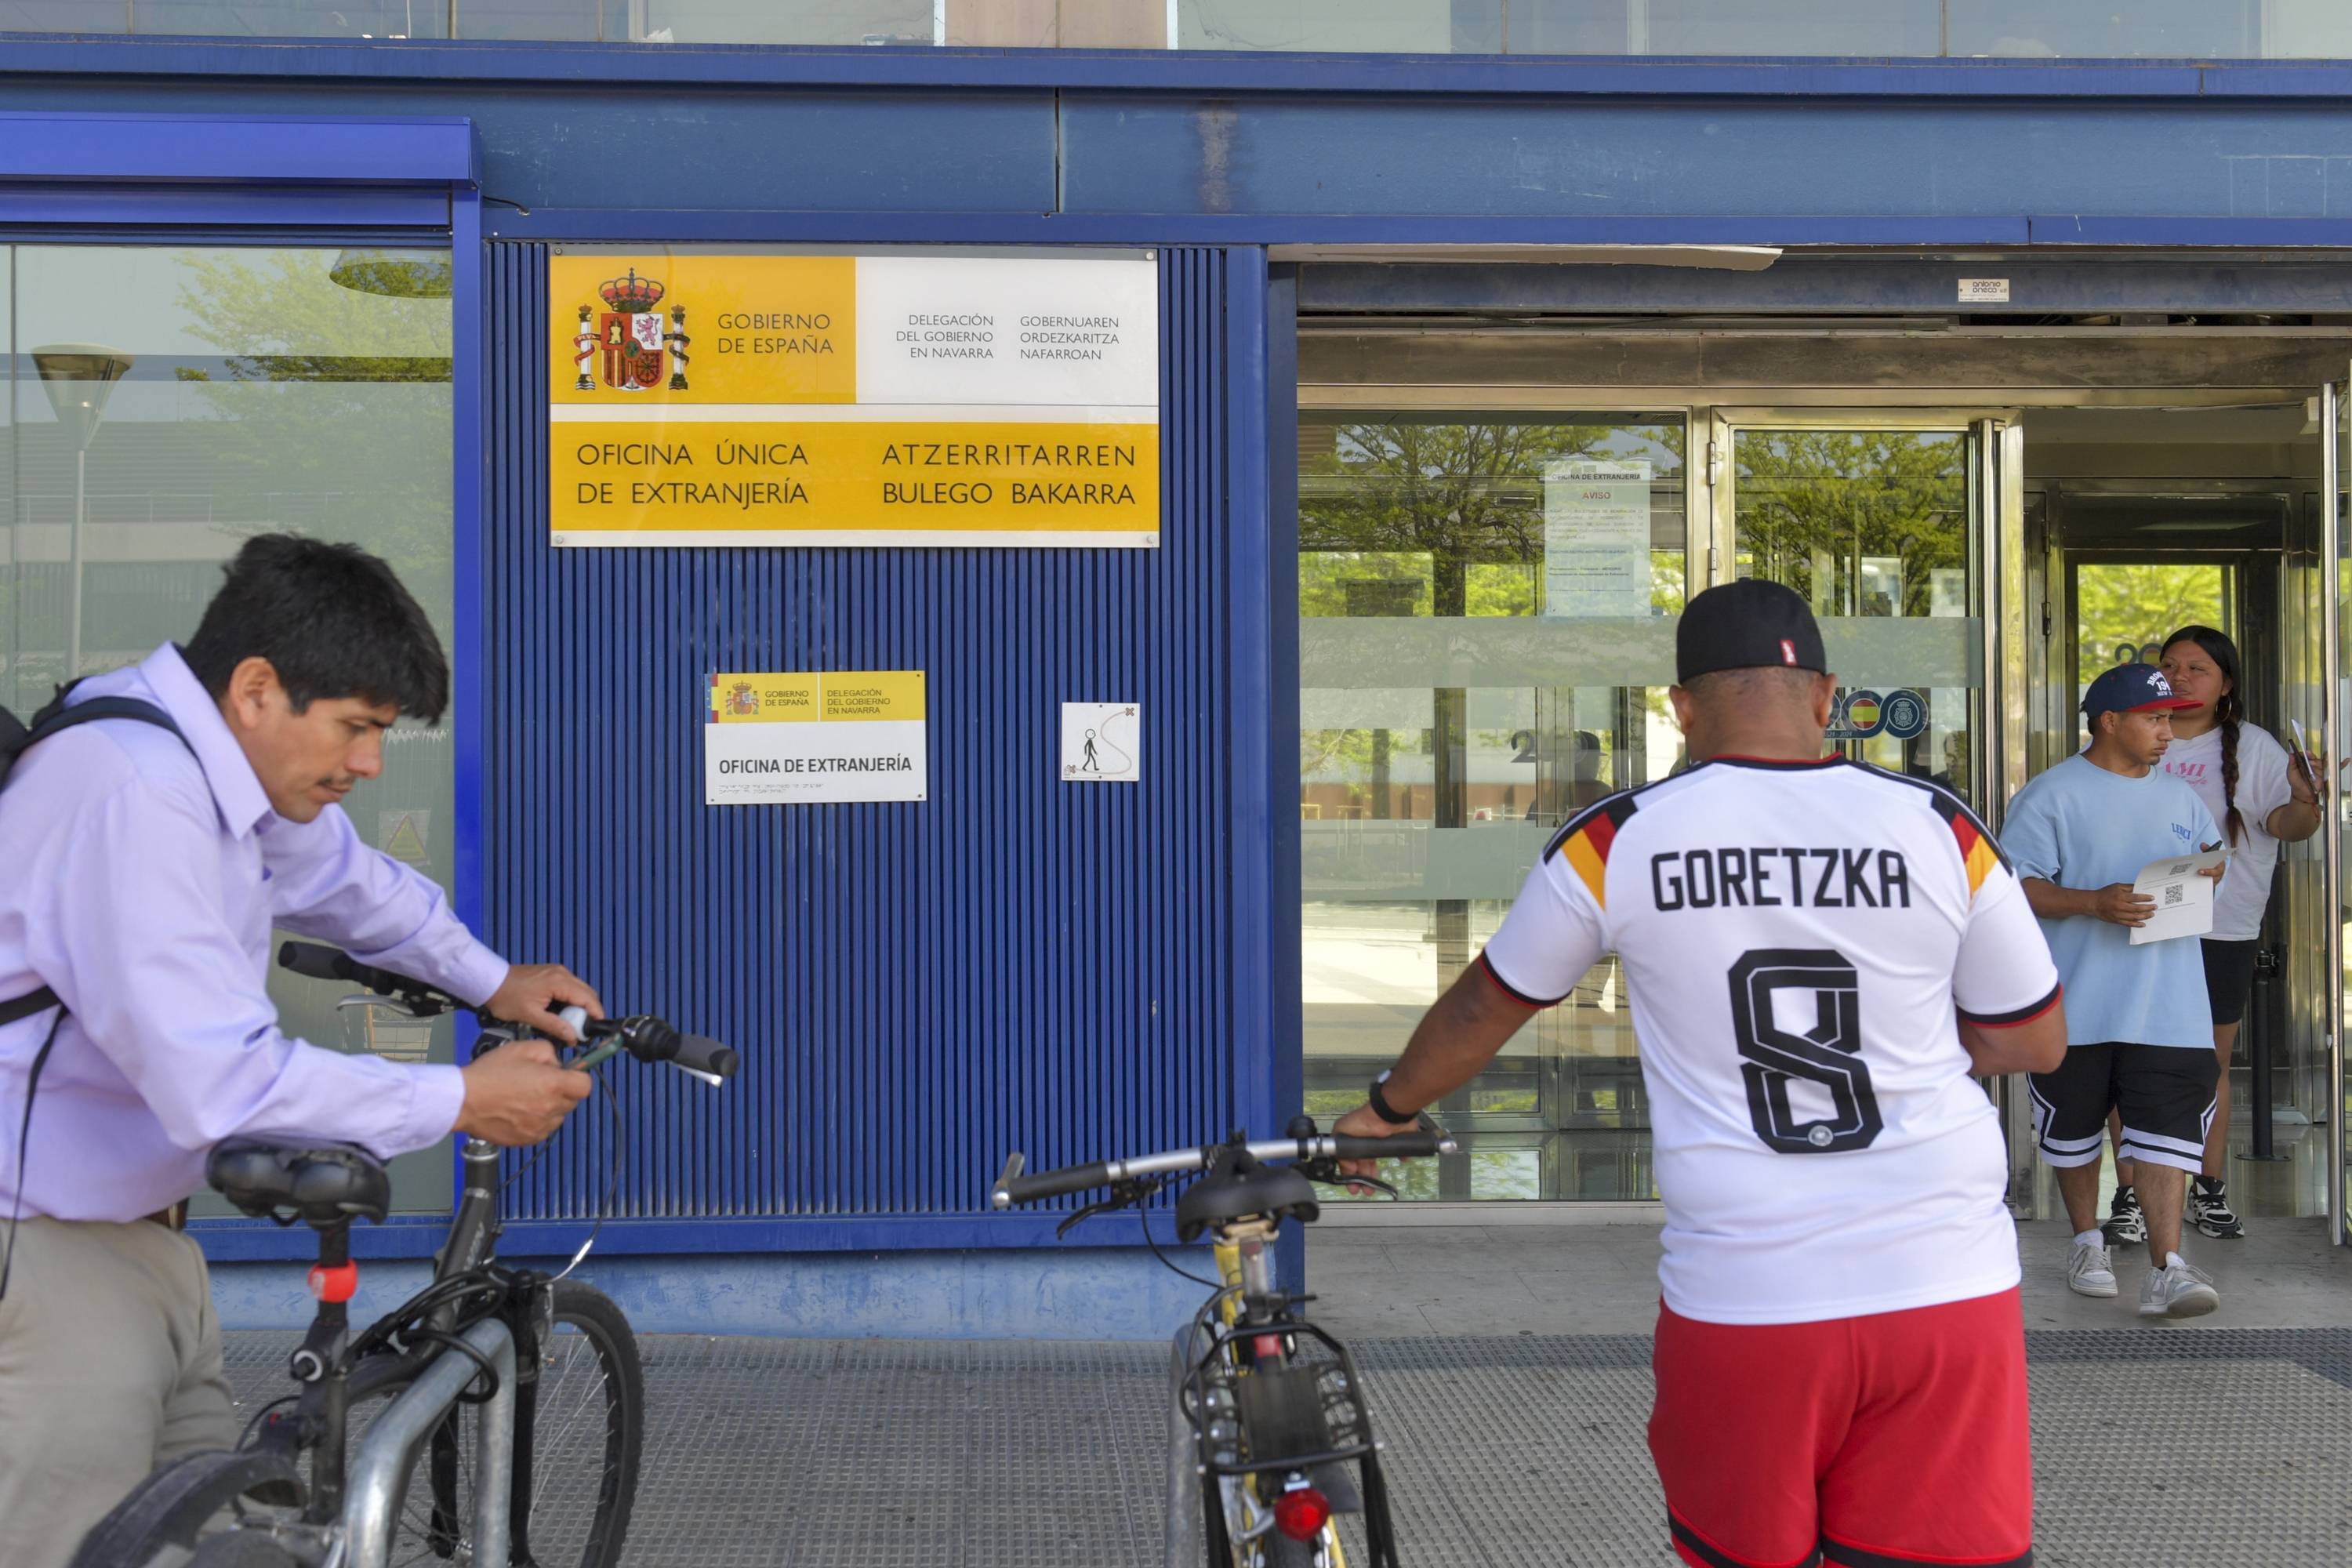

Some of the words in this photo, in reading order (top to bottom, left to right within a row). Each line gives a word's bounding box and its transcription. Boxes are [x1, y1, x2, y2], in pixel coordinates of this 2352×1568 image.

[717, 313, 830, 330] GOBIERNO
[909, 314, 993, 326] DELEGACIÓN
[1020, 316, 1119, 328] GOBERNUAREN
[718, 337, 746, 354] DE
[753, 334, 834, 354] ESPAÑA
[896, 331, 919, 342] DEL
[924, 331, 993, 343] GOBIERNO
[1020, 332, 1120, 344] ORDEZKARITZA
[910, 347, 927, 358] EN
[932, 347, 994, 358] NAVARRA
[1020, 349, 1102, 360] NAFARROAN
[577, 444, 694, 466] OFICINA
[717, 438, 809, 466] ÚNICA
[882, 444, 1135, 466] ATZERRITARREN
[578, 482, 613, 504] DE
[632, 477, 809, 510] EXTRANJERÍA
[884, 482, 993, 504] BULEGO
[1012, 483, 1136, 504] BAKARRA
[827, 688, 882, 697] DELEGACIÓN
[779, 697, 809, 706] ESPAÑA
[719, 759, 781, 774] OFICINA
[784, 759, 804, 772] DE
[808, 753, 913, 772] EXTRANJERÍA
[1651, 848, 1911, 913] GORETZKA
[1727, 948, 1885, 1156] 8
